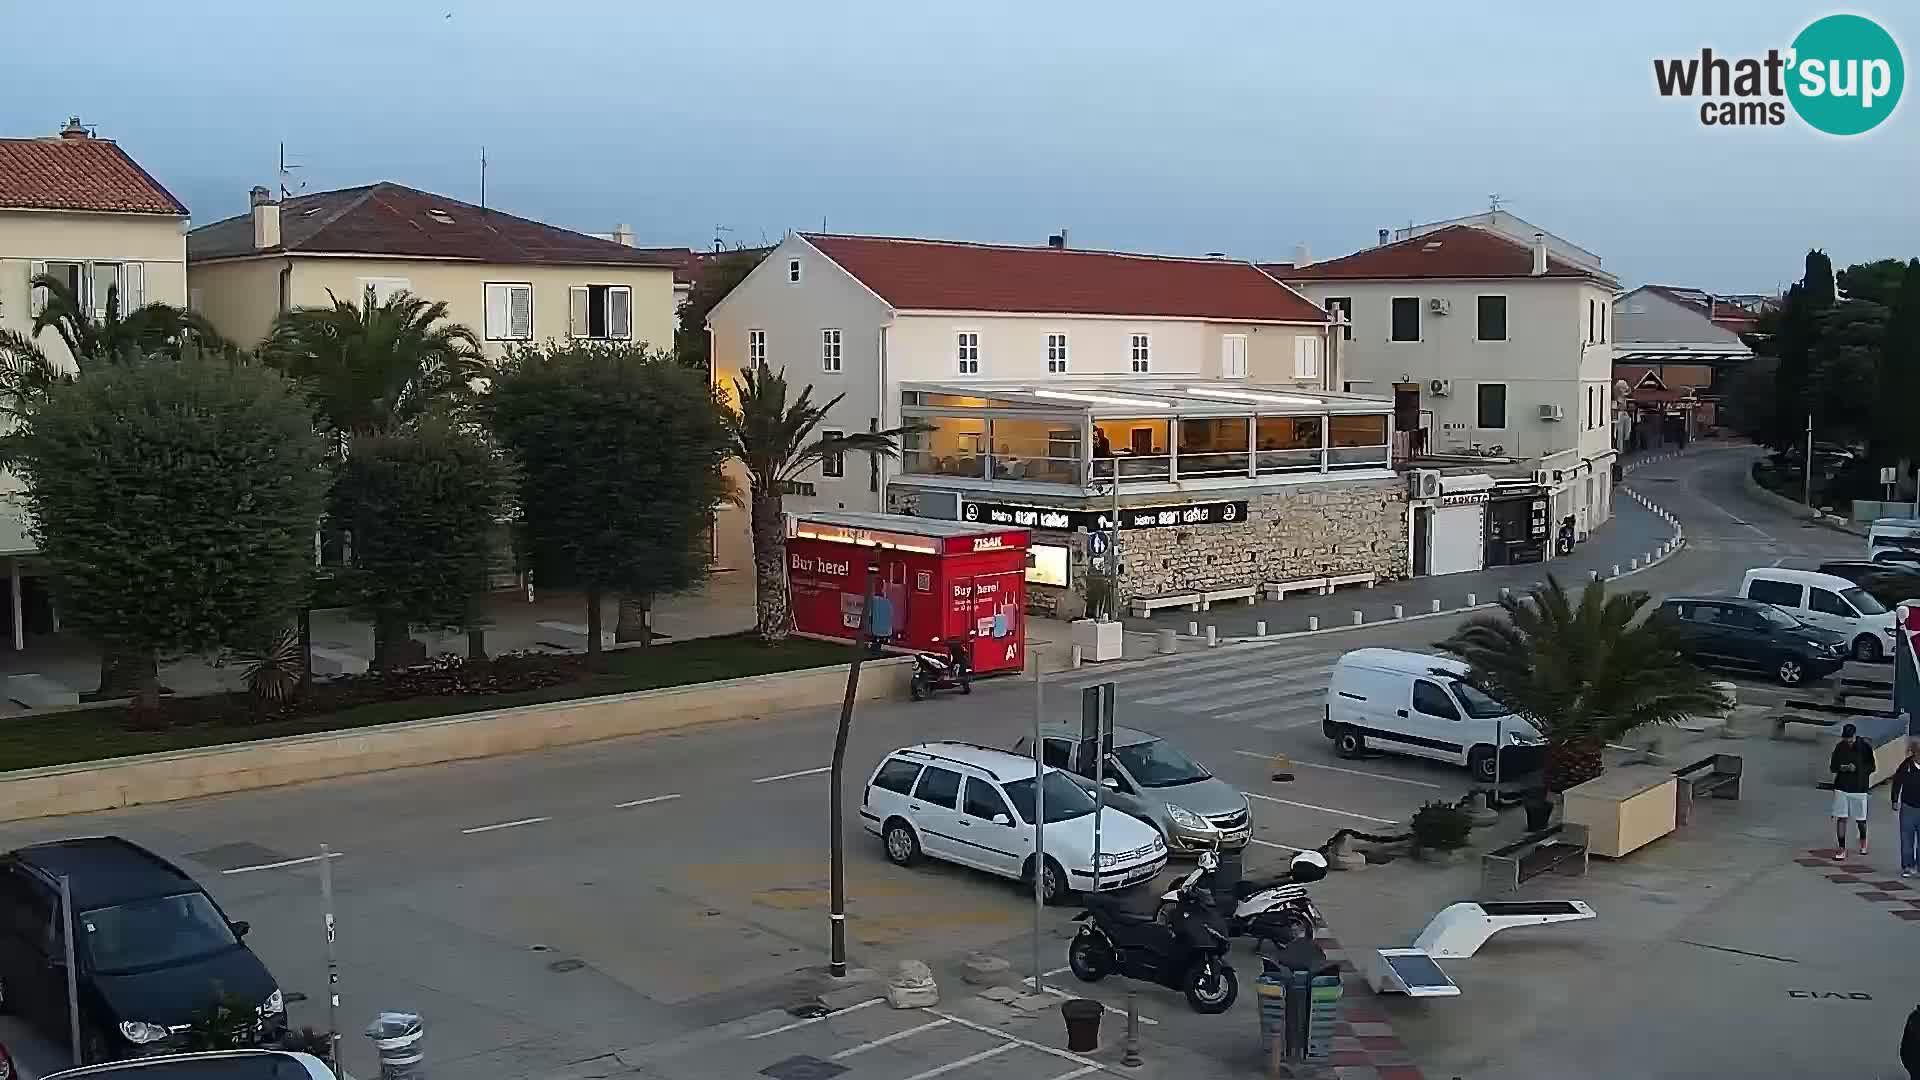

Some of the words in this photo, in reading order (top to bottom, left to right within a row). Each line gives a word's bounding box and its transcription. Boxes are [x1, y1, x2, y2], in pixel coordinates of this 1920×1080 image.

[1134, 514, 1156, 526] bistro
[973, 536, 1003, 549] TISAK
[816, 556, 849, 576] here!
[953, 585, 972, 598] Buy
[976, 580, 1000, 595] here!
